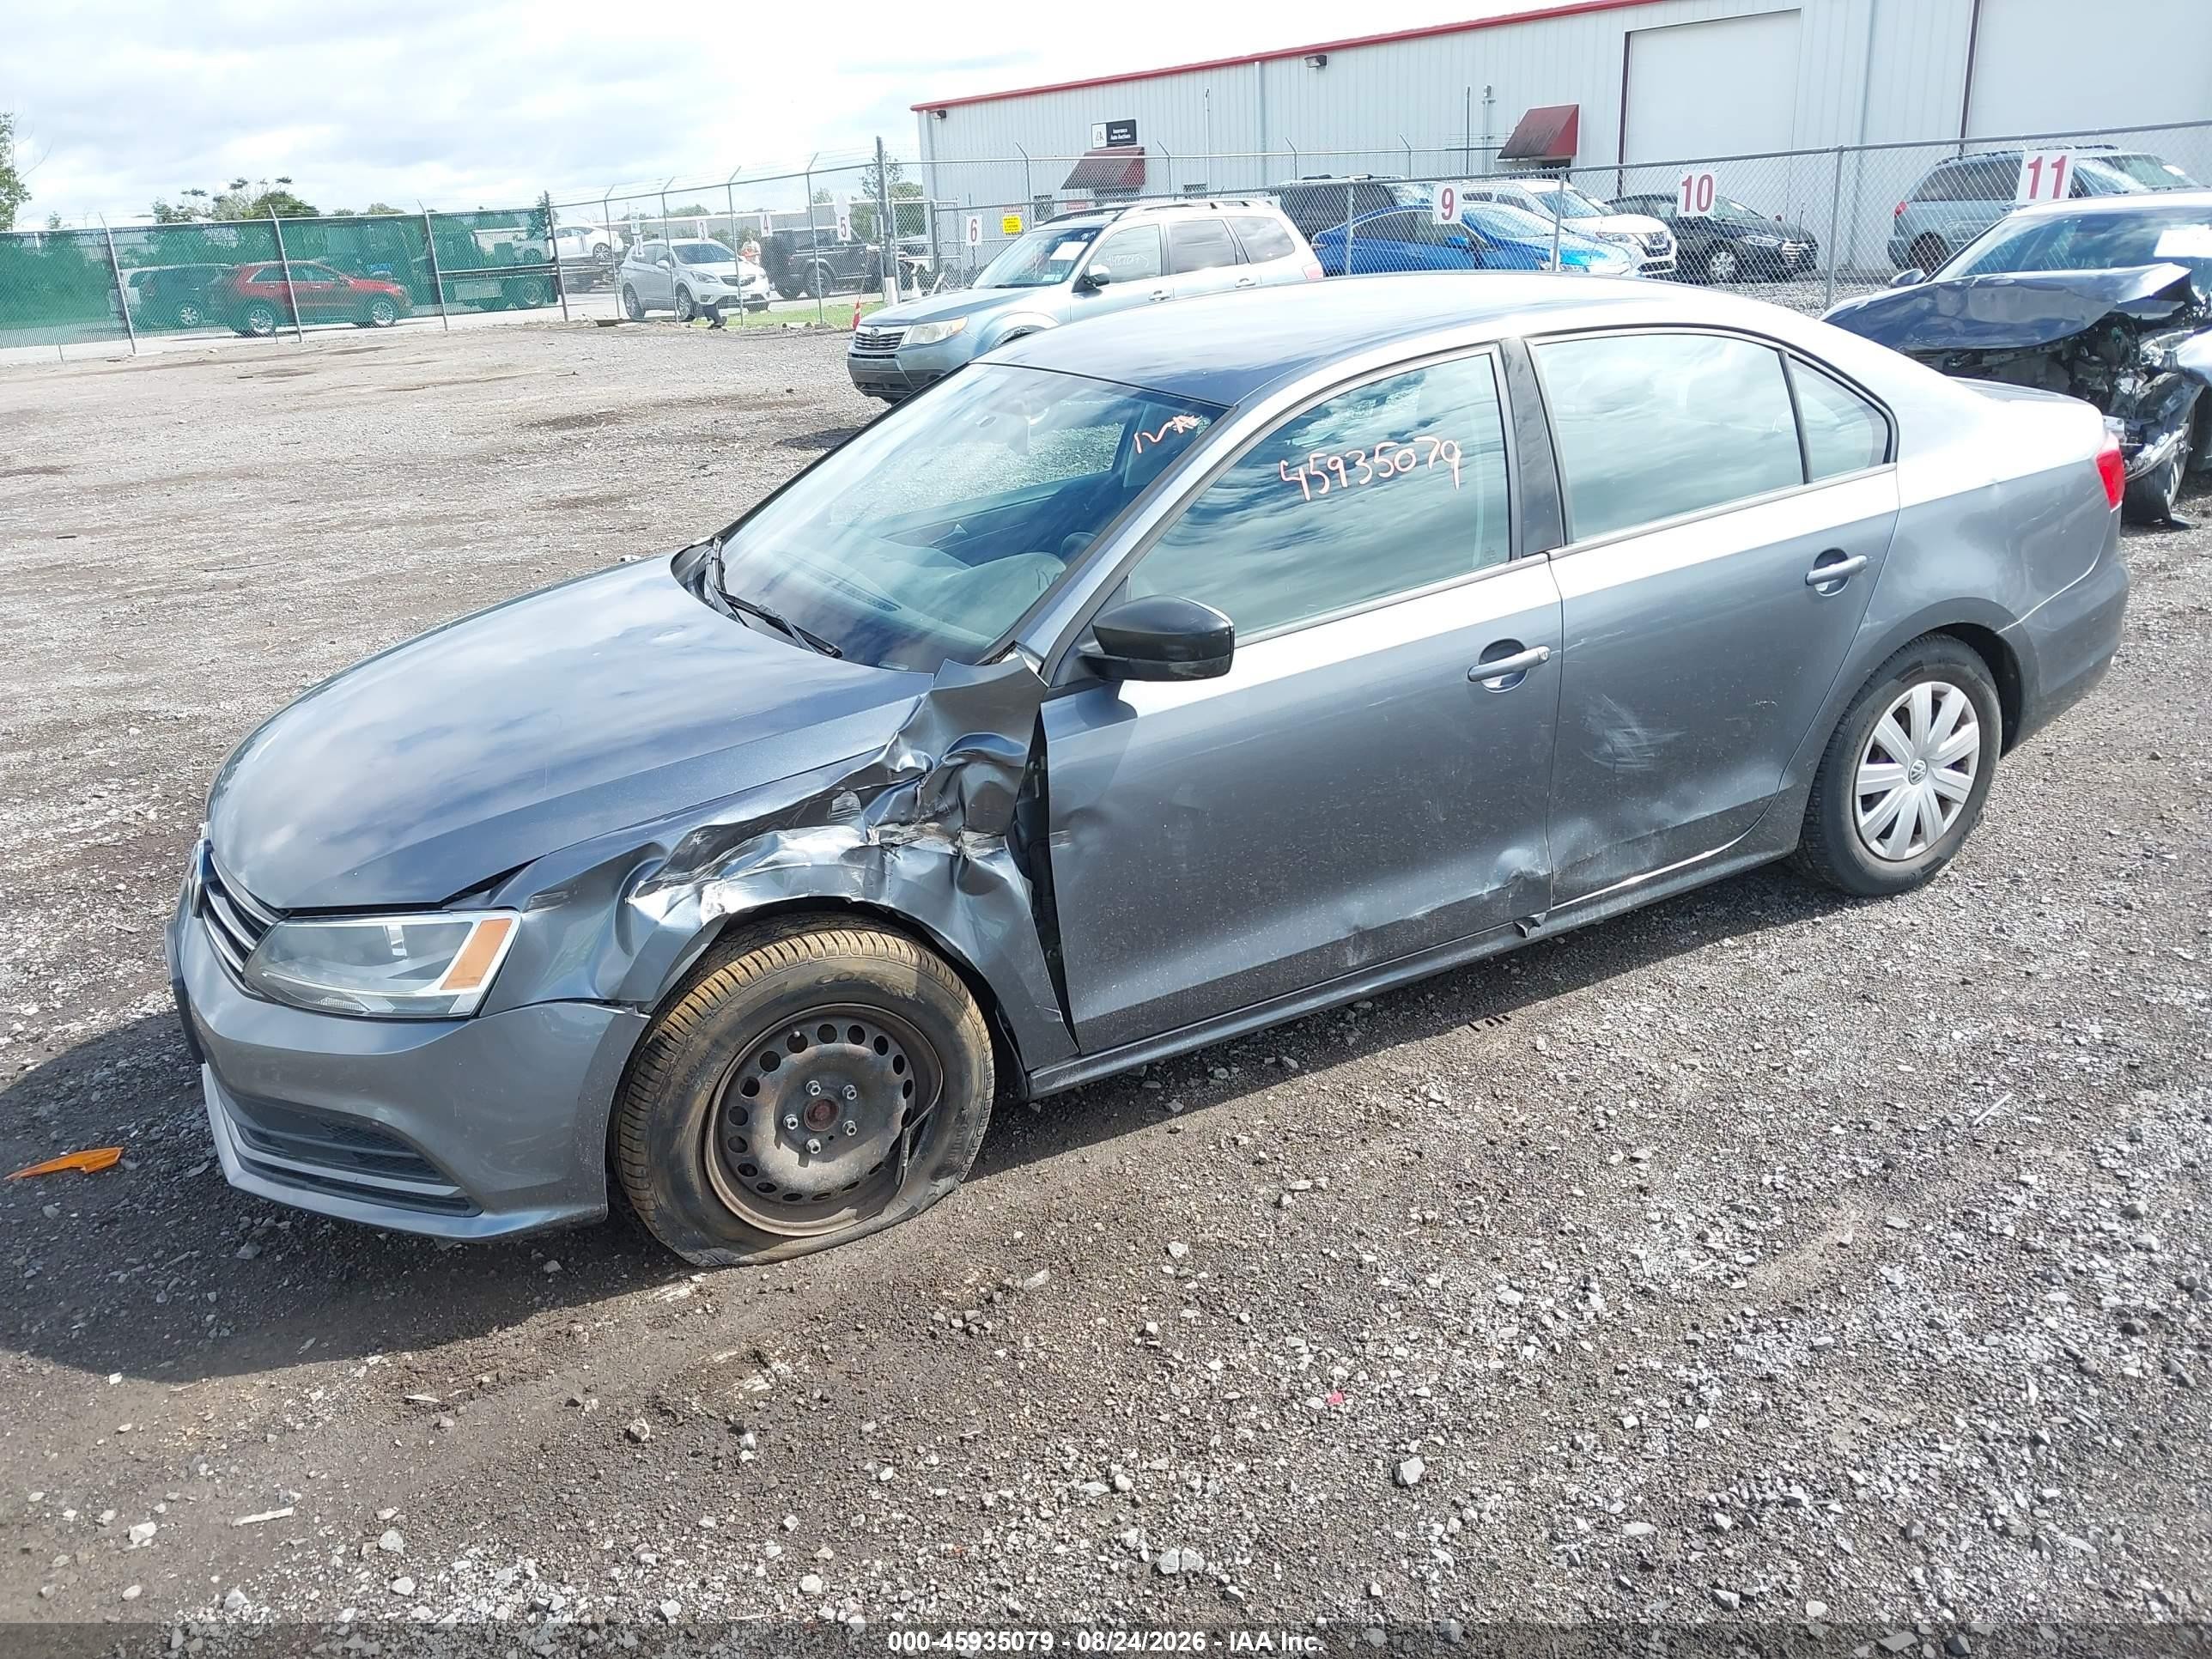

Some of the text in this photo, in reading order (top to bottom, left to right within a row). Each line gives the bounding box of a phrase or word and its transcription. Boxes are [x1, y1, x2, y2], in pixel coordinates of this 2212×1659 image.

[2027, 155, 2068, 199] 11
[1441, 187, 1455, 221] 9
[1681, 174, 1713, 212] 10
[698, 222, 706, 241] 3
[763, 213, 769, 233] 4
[840, 216, 847, 238] 5
[970, 218, 977, 242] 6
[1279, 436, 1462, 501] 45935079
